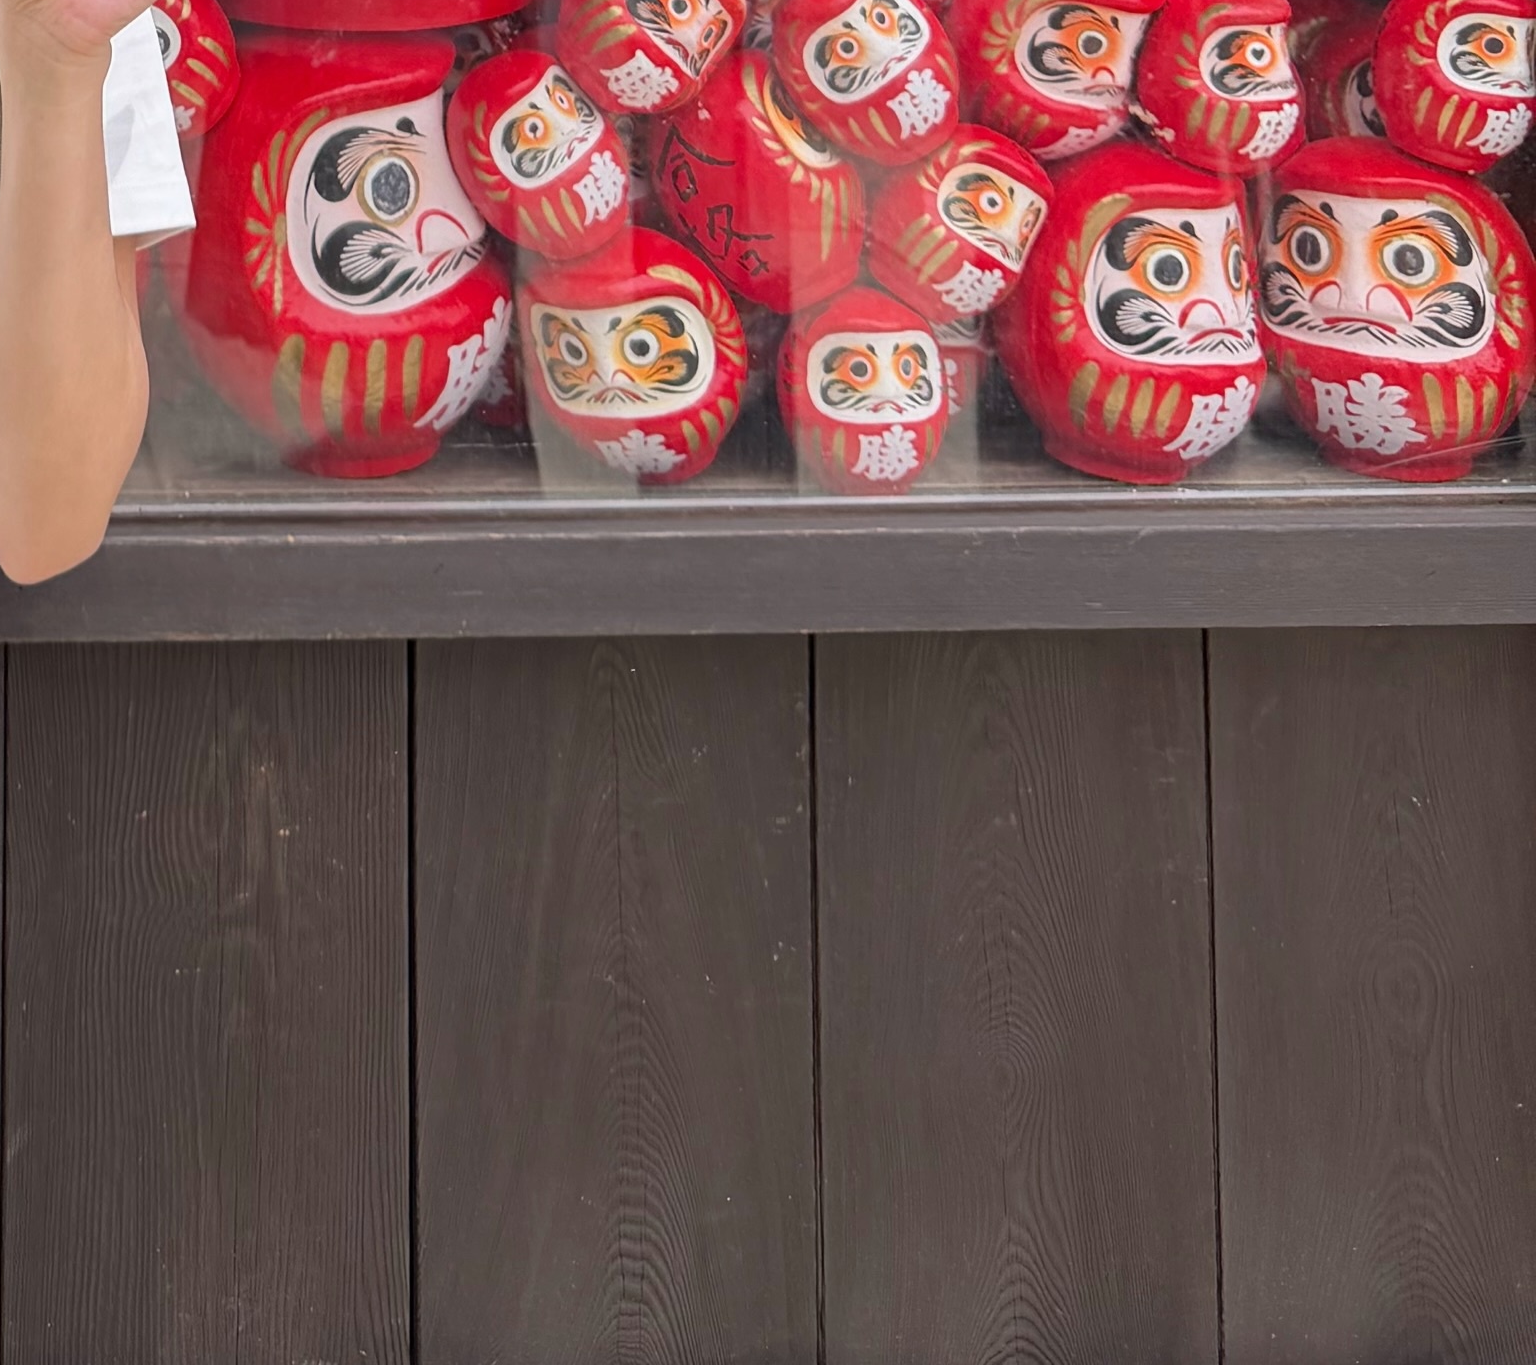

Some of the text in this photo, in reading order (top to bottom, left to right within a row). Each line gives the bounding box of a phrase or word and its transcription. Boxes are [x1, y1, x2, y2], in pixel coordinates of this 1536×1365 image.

[600, 49, 679, 110] 勝
[887, 68, 950, 139] 勝
[1237, 102, 1300, 160] 勝
[1466, 102, 1532, 156] 勝
[573, 150, 627, 227] 勝
[933, 259, 1006, 315] 勝
[1162, 374, 1256, 461] 勝
[1311, 372, 1427, 456] 勝
[851, 424, 919, 481] 勝
